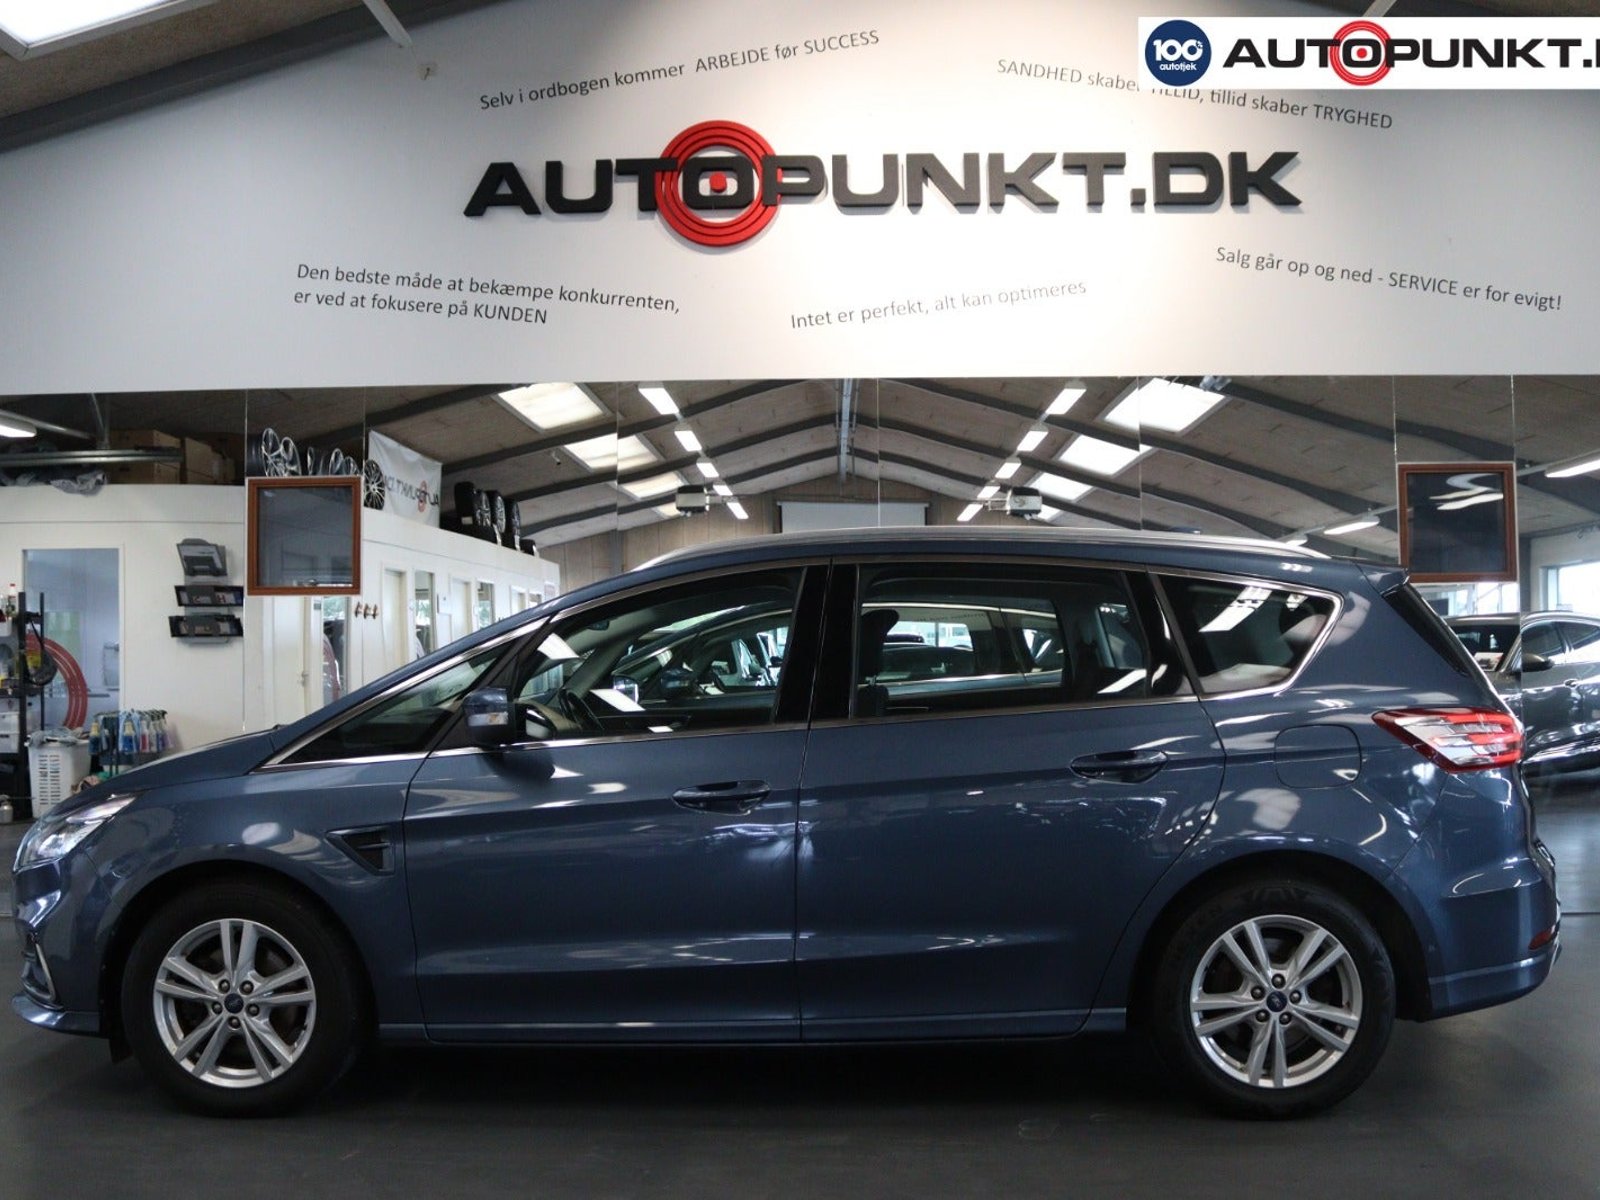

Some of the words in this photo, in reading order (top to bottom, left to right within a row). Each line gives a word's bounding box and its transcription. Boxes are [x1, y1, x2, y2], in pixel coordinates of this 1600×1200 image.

[480, 92, 514, 110] Selv
[519, 88, 524, 103] i
[528, 76, 610, 101] ordbogen
[614, 64, 686, 86] kommer
[695, 47, 770, 72] ARBEJDE
[775, 43, 799, 59] før
[803, 29, 880, 54] SUCCESS
[997, 59, 1082, 83] SANDHED
[1210, 89, 1248, 107] tillid
[1252, 95, 1308, 117] skaber
[1313, 104, 1393, 129] TRYGHED
[463, 151, 1302, 216] AUTOPUNKT.DK
[294, 291, 311, 304] er
[316, 292, 345, 307] ved
[350, 294, 366, 308] at
[371, 293, 443, 314] fokusere
[447, 300, 468, 318] på
[473, 303, 548, 325] KUNDEN
[297, 264, 330, 280] Den
[334, 266, 390, 286] bedste
[395, 272, 443, 290] måde
[447, 277, 464, 292] at
[469, 277, 554, 302] bekæmpe
[558, 286, 680, 315] konkurrenten,
[791, 311, 833, 329] Intet
[837, 309, 855, 323] er
[861, 299, 929, 324] perfekt,
[935, 295, 957, 312] alt
[962, 292, 993, 308] kan
[998, 280, 1087, 306] optimeres
[1216, 247, 1251, 269] Salg
[1255, 253, 1283, 271] går
[1287, 260, 1309, 277] op
[1314, 264, 1335, 282] og
[1340, 268, 1373, 284] ned
[1388, 271, 1458, 296] SERVICE
[1463, 285, 1481, 299] er
[1486, 285, 1510, 302] for
[1514, 291, 1562, 313] evigt!
